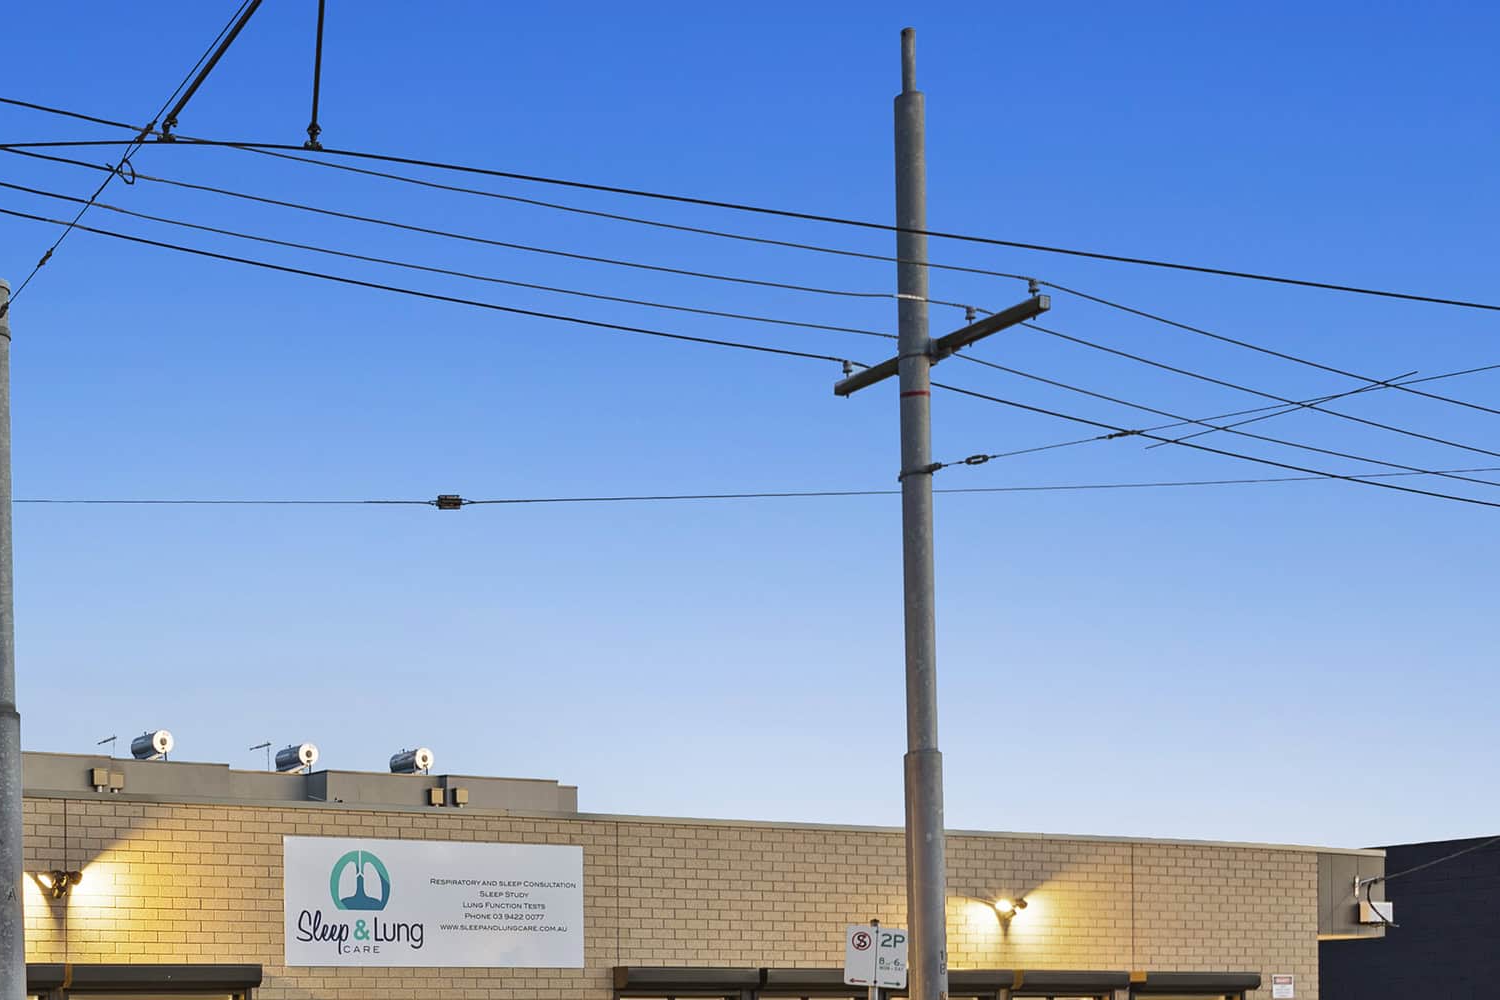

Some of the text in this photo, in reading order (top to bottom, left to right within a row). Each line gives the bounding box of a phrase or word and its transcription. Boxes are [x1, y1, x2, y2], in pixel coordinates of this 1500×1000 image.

[430, 878, 480, 886] RESPIRATORY
[523, 880, 576, 889] CONSULTATION
[479, 890, 529, 898] SLEEP STUDY
[485, 902, 522, 910] FUNCTION
[523, 902, 546, 910] TESTS
[504, 913, 524, 921] 9422
[296, 910, 424, 955] Sleep & Lung
[880, 933, 905, 948] 2P
[343, 945, 380, 954] CARE
